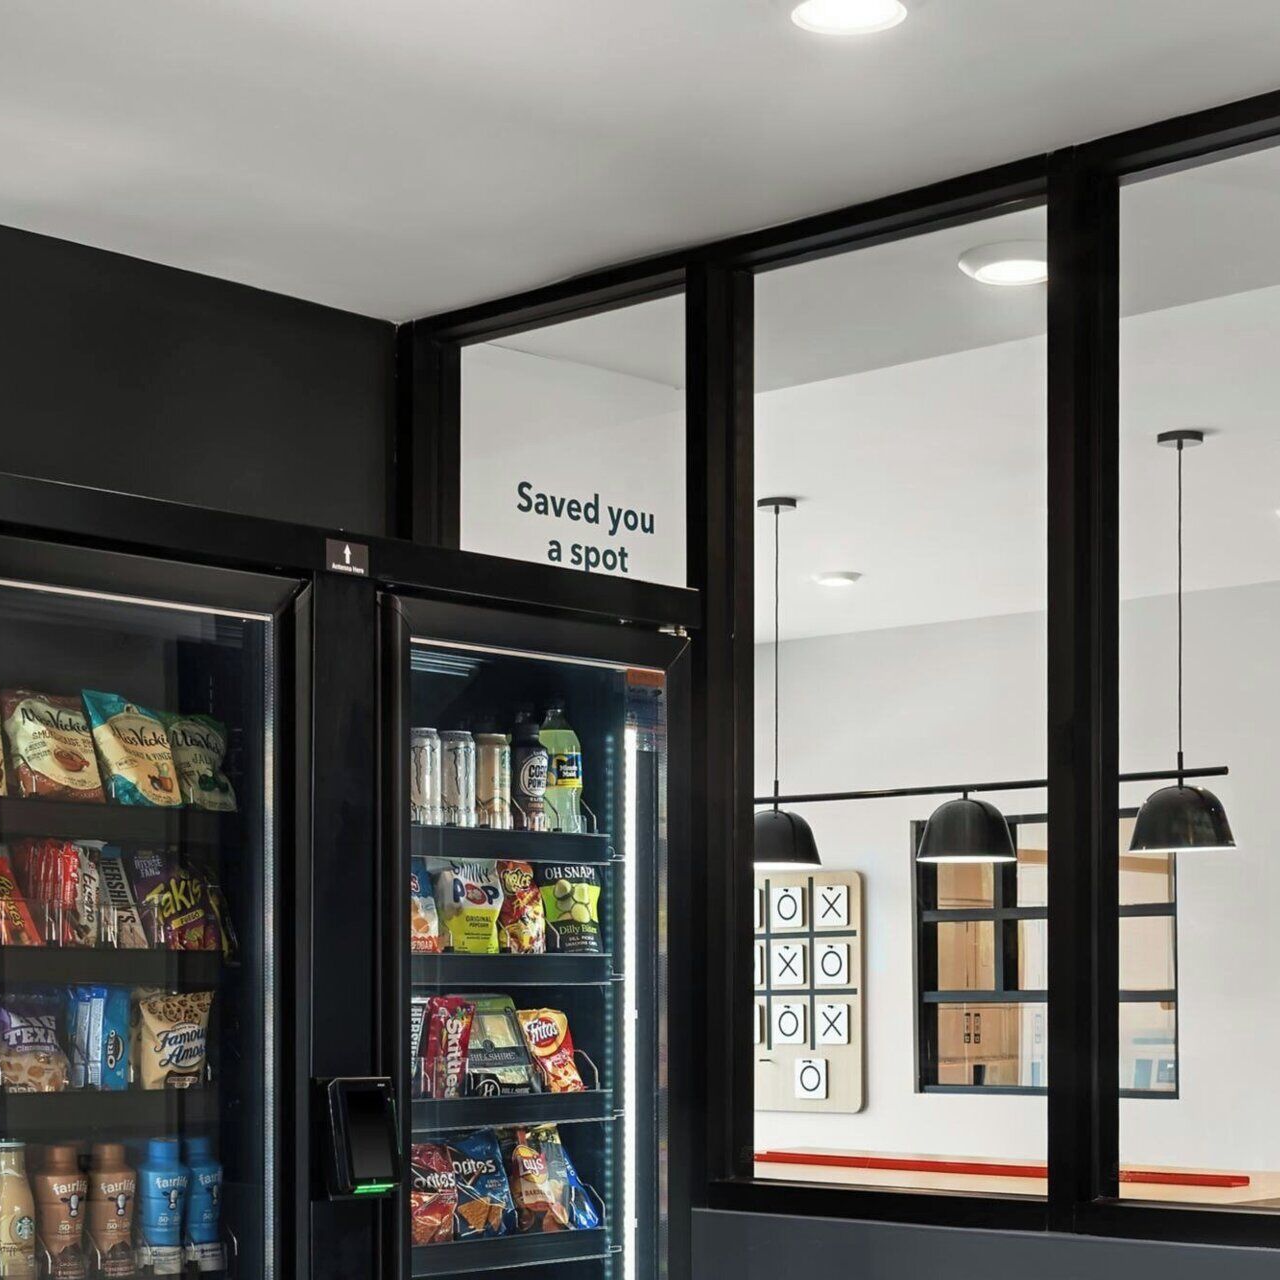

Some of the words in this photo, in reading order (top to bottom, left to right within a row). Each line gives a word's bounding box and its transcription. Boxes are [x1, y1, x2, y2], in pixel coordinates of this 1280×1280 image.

[516, 481, 600, 524] Saved
[607, 506, 655, 536] you
[547, 539, 562, 562] a
[570, 542, 629, 573] spot
[545, 867, 562, 879] OH
[564, 866, 596, 880] SNAP!
[146, 877, 202, 924] Takis
[452, 878, 500, 905] POP
[465, 914, 492, 922] ORIGINAL
[5, 1028, 57, 1046] TEXA
[154, 1028, 206, 1053] Famou
[528, 1019, 559, 1043] Fritos
[445, 1018, 462, 1098] Skittles
[470, 1053, 516, 1062] HILLSHIRE
[523, 1157, 544, 1175] ay's
